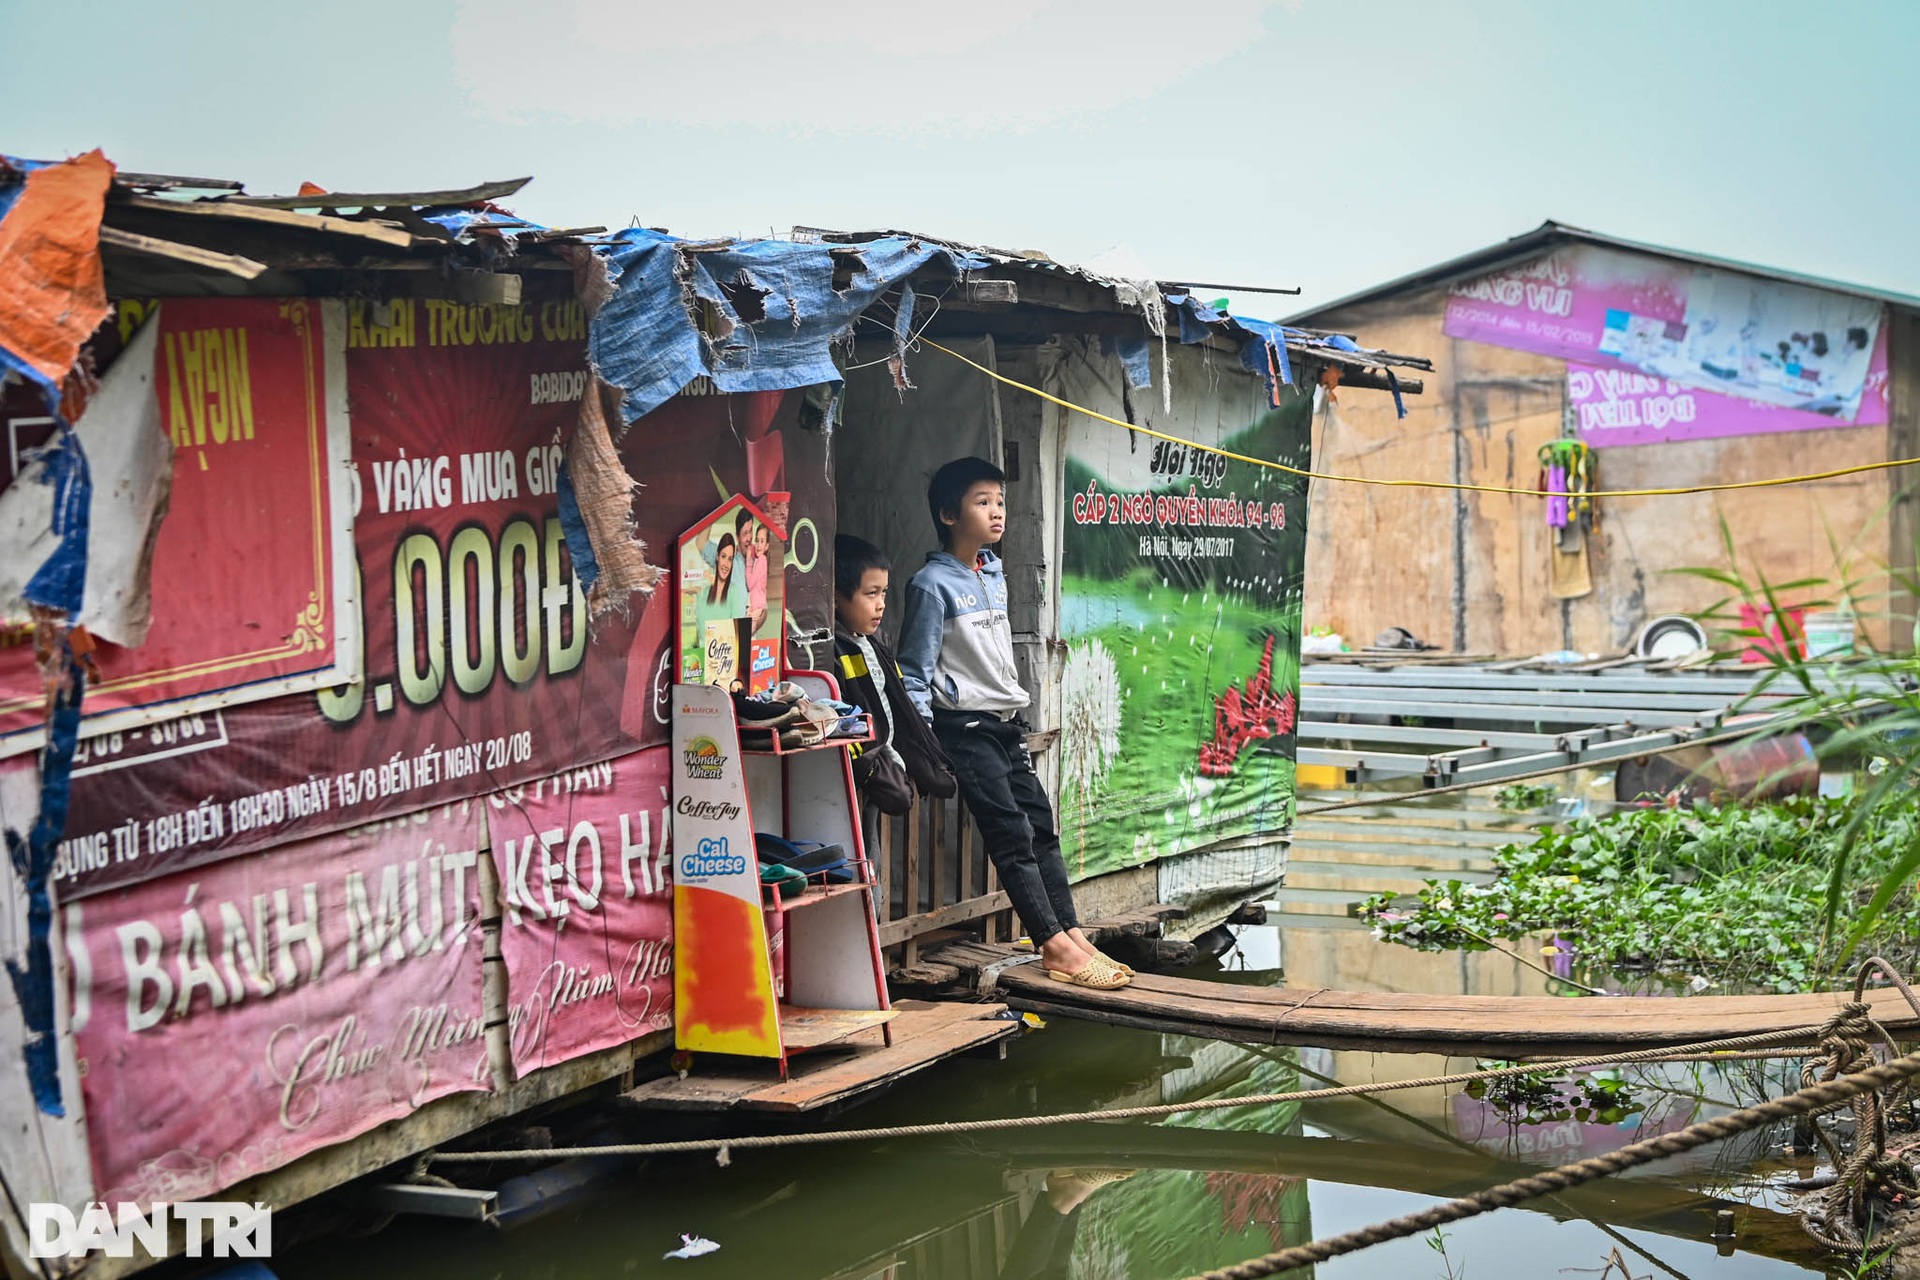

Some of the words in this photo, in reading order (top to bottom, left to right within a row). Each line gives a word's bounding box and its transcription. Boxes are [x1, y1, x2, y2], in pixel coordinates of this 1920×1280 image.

[165, 328, 255, 471] NGÀY
[530, 370, 587, 405] BABIDA
[372, 447, 452, 514] VÀNG
[460, 449, 518, 505] MUA
[1073, 478, 1106, 525] CẤP
[1108, 493, 1119, 525] 2
[1121, 489, 1154, 525] NGÔ
[1208, 491, 1245, 528] KHÓA
[1246, 502, 1263, 529] 94
[1270, 502, 1286, 530] 98
[1139, 535, 1151, 556] Hà
[1171, 537, 1192, 561] Ngày
[1193, 537, 1235, 558] 29/07/2017
[317, 518, 587, 722] .000Đ
[708, 638, 732, 659] Coffee
[758, 645, 770, 658] Cal
[717, 656, 733, 675] Joy
[752, 656, 775, 673] Cheese
[683, 749, 728, 767] Wonder
[686, 763, 723, 780] Wheat
[146, 812, 183, 854] 18H
[186, 795, 224, 845] ĐẾN
[229, 789, 285, 834] 18H30
[286, 774, 331, 820] NGÀY
[335, 768, 377, 808] 15/8
[379, 751, 411, 797] ĐẾN
[413, 743, 442, 789] HẾT
[485, 731, 532, 771] 20/08
[698, 836, 729, 858] Cal
[681, 854, 746, 877] Cheese
[116, 882, 323, 1033] BÁNH
[345, 839, 477, 972] MỨT
[505, 820, 603, 932] KẸO
[266, 1014, 384, 1131] Chúc
[516, 961, 616, 1062] Năm
